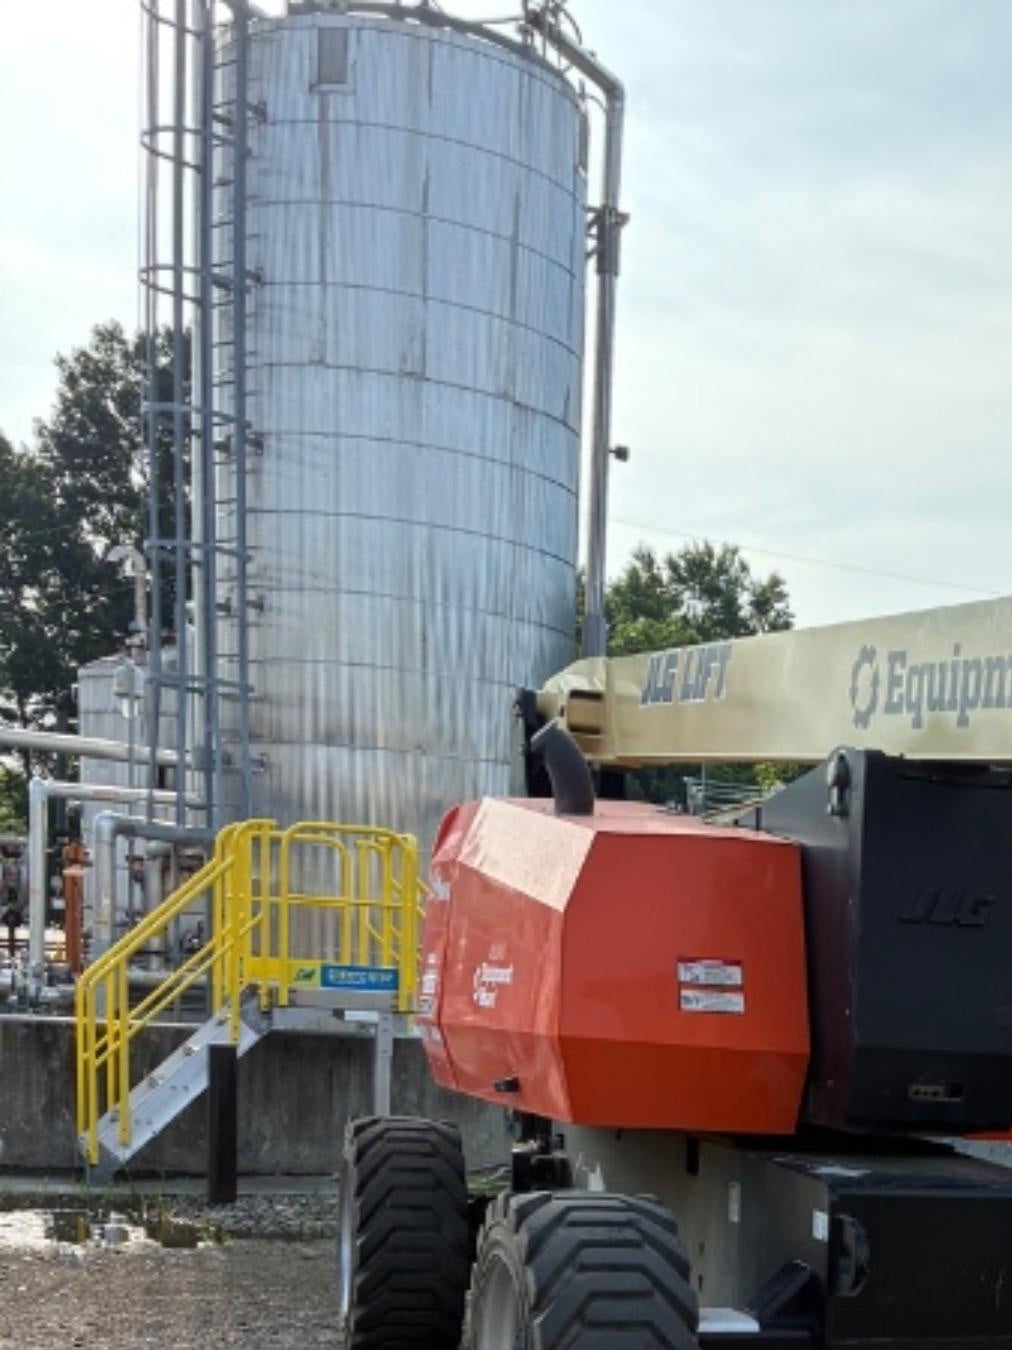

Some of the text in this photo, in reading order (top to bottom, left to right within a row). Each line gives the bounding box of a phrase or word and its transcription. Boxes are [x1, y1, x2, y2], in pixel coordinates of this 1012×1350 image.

[640, 641, 733, 705] JLG LIFT
[898, 888, 998, 928] JLG
